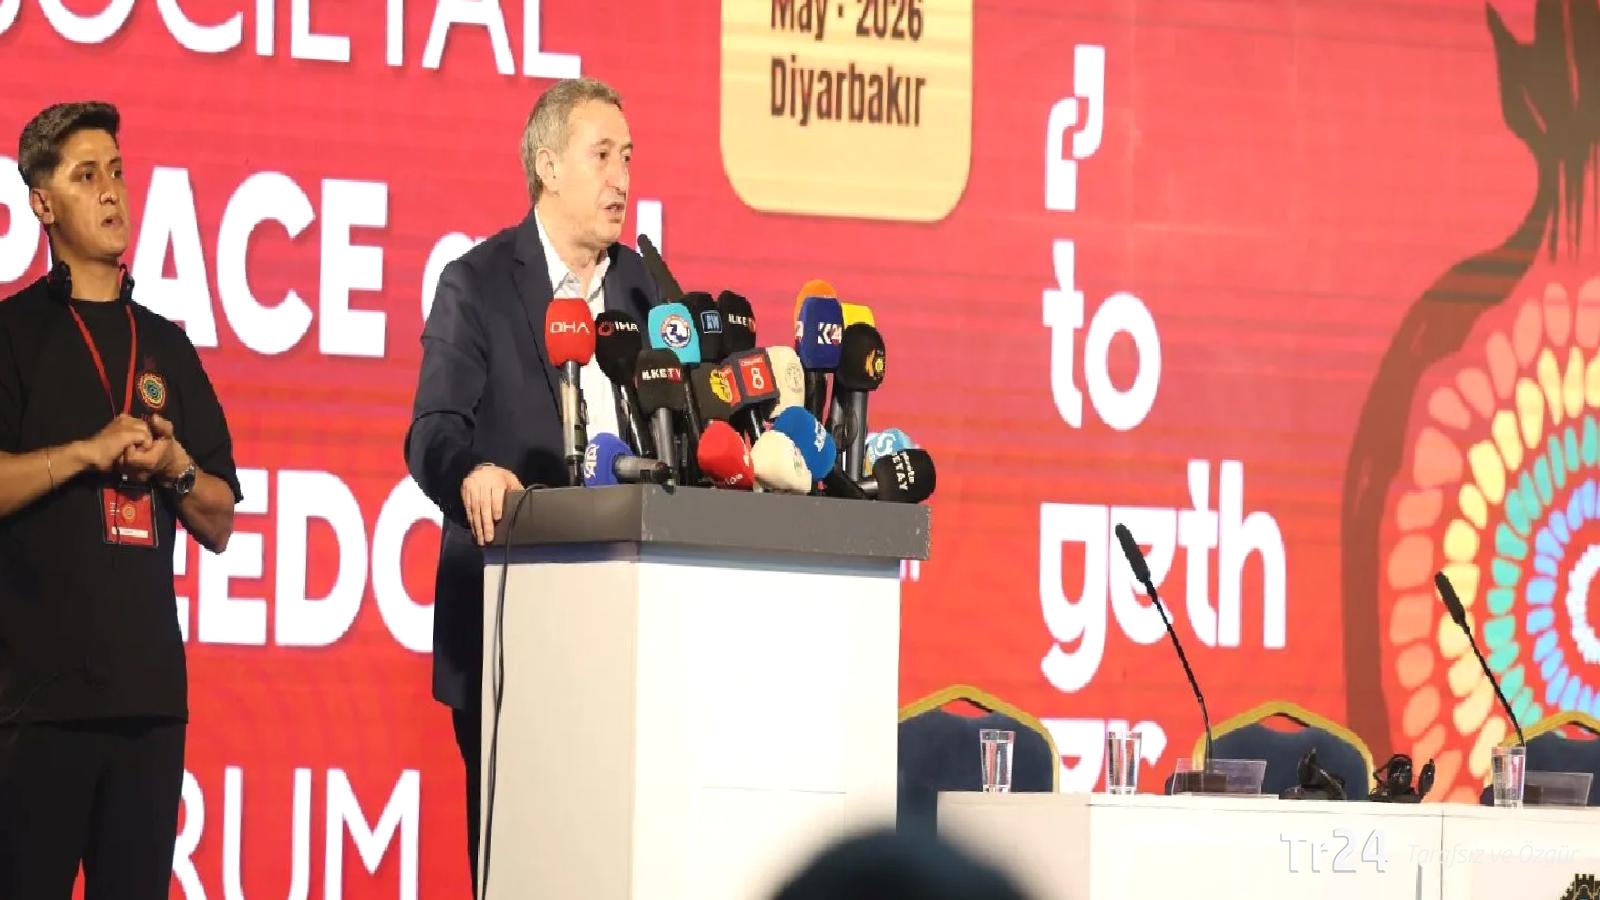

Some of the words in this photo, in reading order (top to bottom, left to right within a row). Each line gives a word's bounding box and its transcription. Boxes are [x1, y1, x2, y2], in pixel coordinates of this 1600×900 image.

[855, 0, 924, 41] 2026
[770, 54, 926, 127] Diyarbakır
[551, 321, 591, 336] DHA
[1042, 238, 1162, 431] to
[1040, 459, 1287, 692] geth
